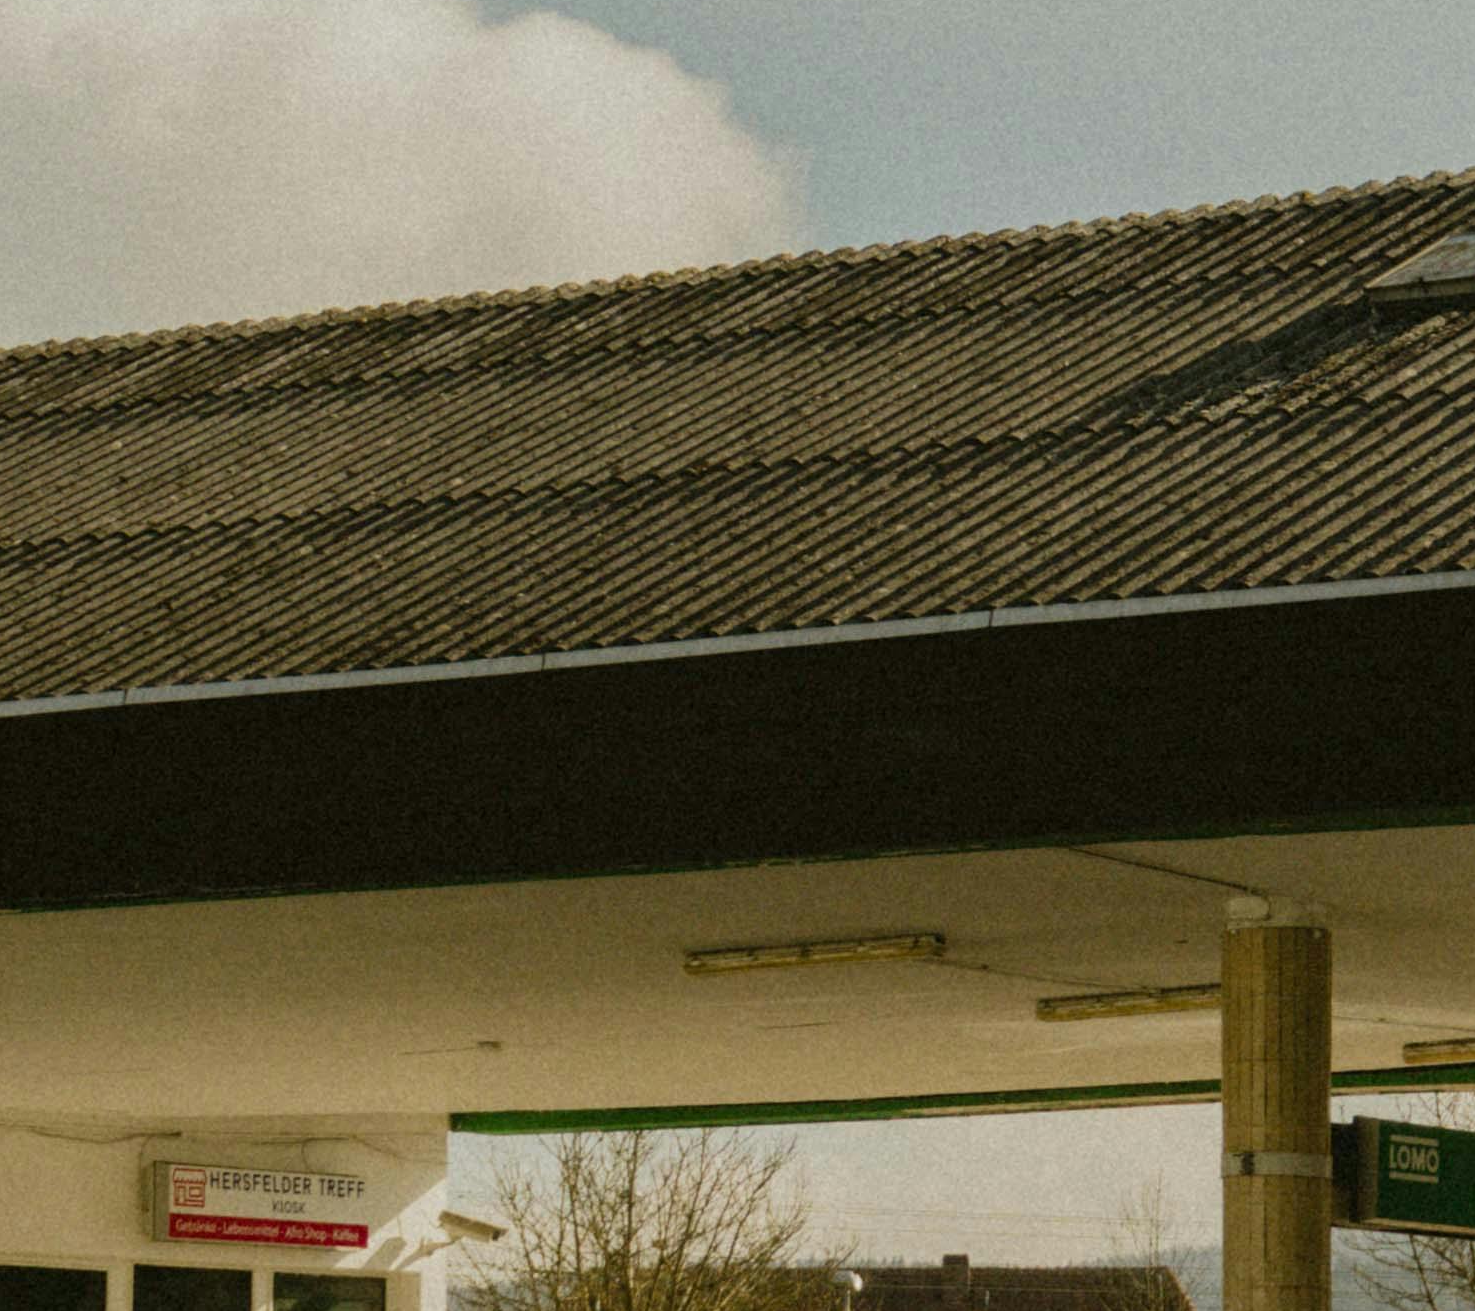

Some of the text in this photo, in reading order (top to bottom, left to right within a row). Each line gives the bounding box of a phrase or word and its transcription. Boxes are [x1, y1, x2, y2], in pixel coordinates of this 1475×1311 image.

[1389, 1144, 1440, 1173] LOMO
[210, 1171, 365, 1199] HERSFELDER TREFF
[272, 1200, 306, 1214] KIOSK
